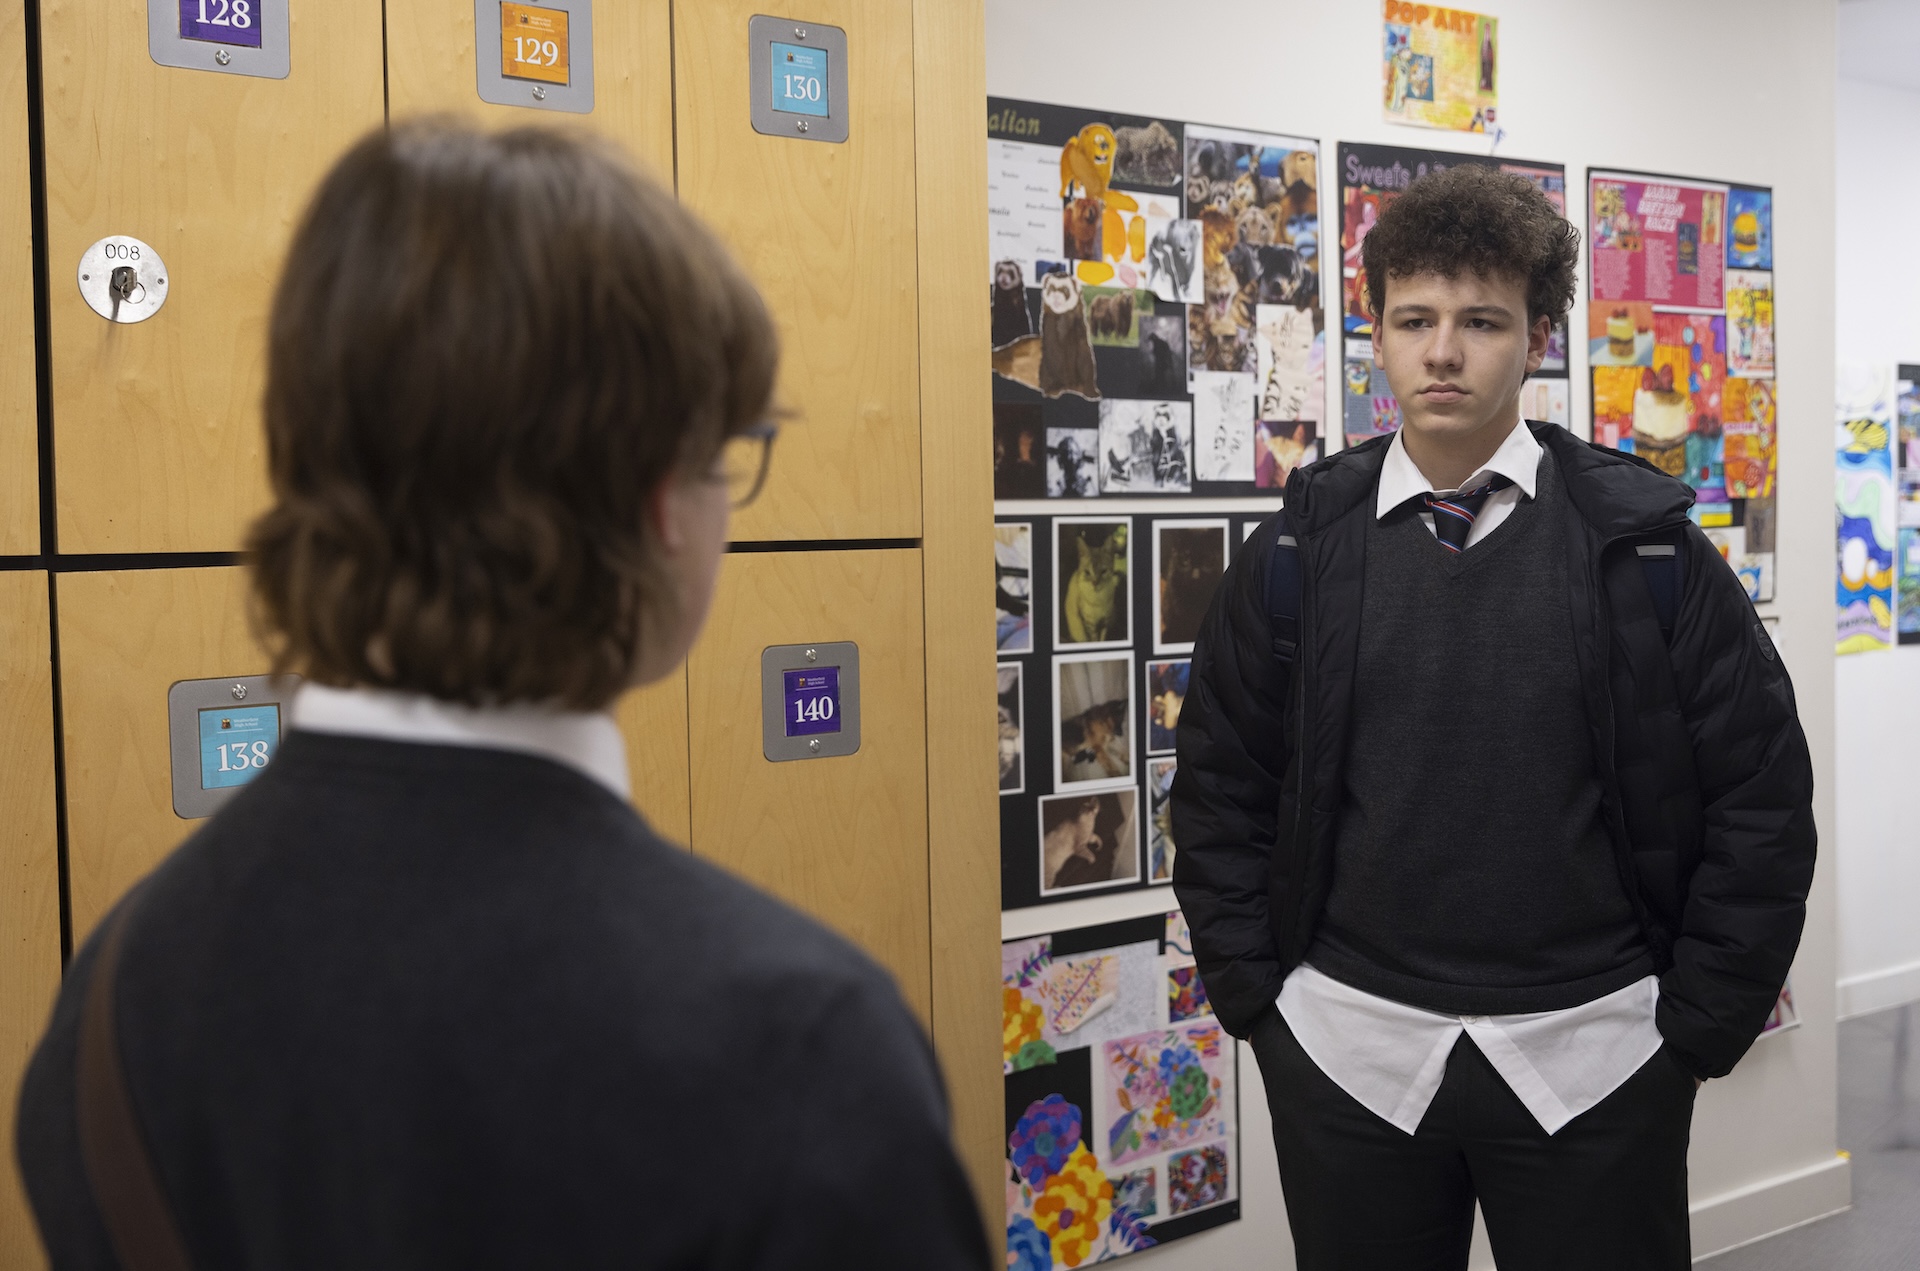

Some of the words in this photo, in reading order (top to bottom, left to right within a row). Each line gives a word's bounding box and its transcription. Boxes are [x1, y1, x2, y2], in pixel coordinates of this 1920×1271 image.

[196, 0, 252, 29] 128
[1384, 0, 1429, 26] POP
[1433, 8, 1476, 34] ART
[513, 36, 559, 67] 129
[783, 74, 821, 102] 130
[1345, 153, 1411, 188] Sweets
[105, 243, 141, 261] 008
[794, 696, 834, 723] 140
[216, 740, 270, 772] 138
